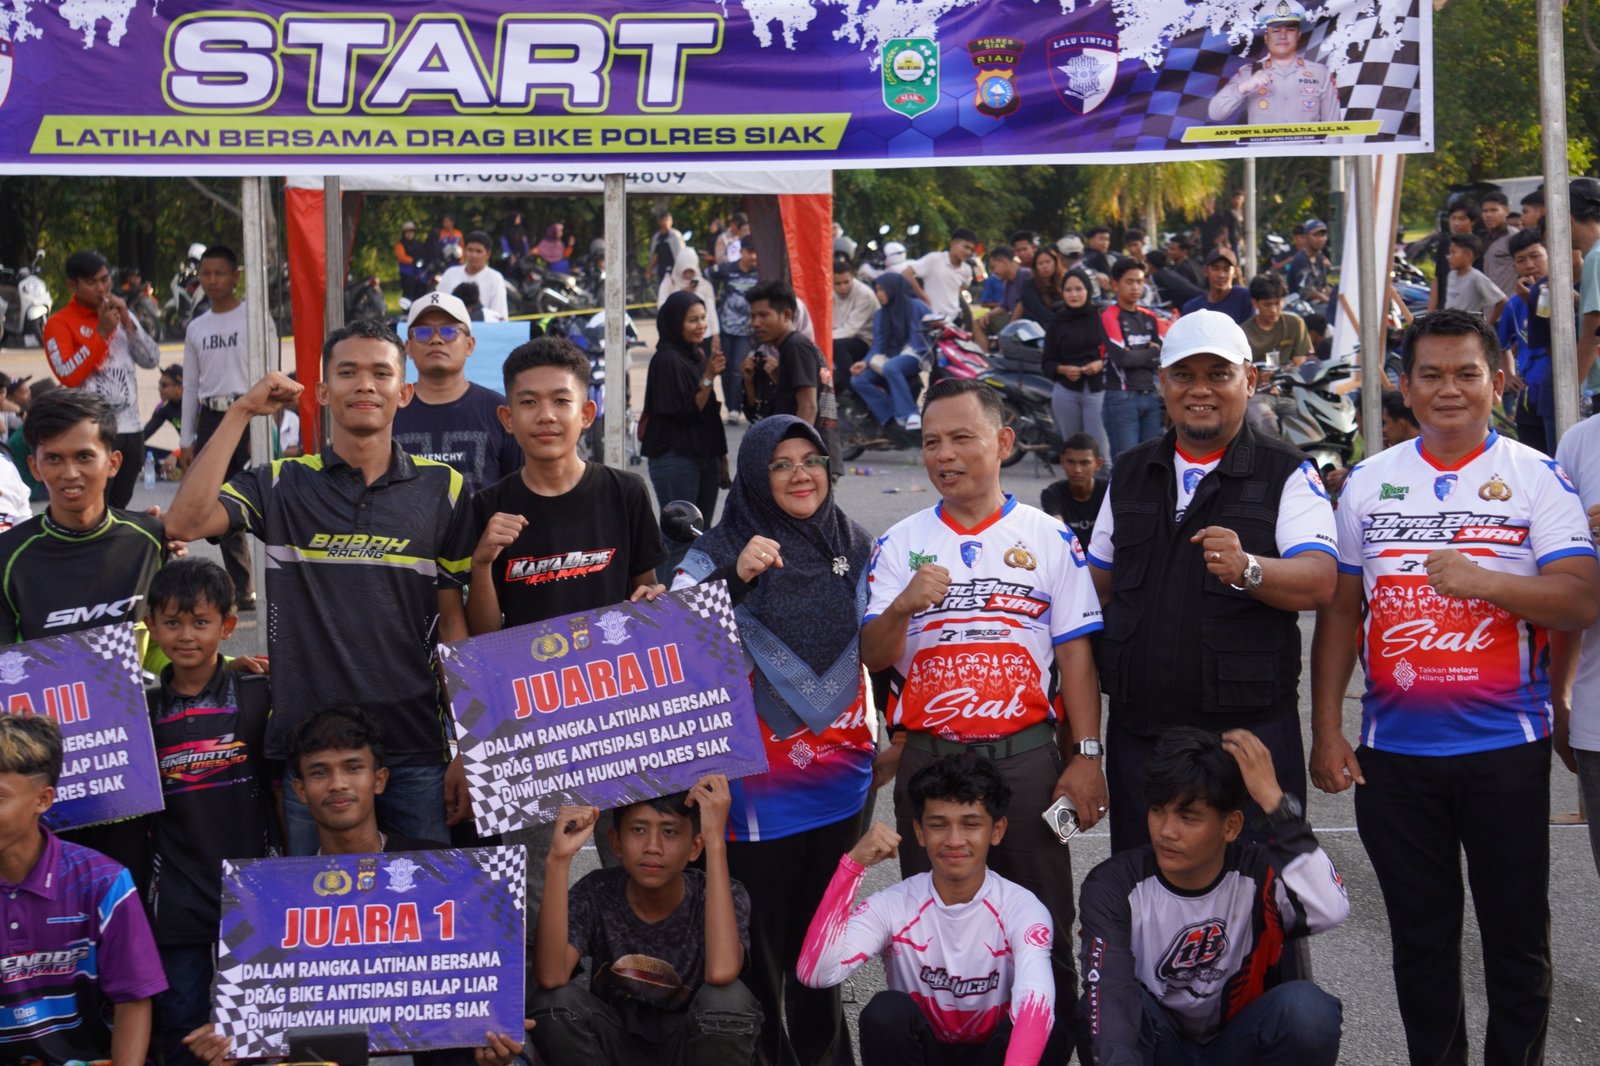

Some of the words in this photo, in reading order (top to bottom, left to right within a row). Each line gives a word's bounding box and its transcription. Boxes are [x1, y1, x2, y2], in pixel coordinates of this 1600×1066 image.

[977, 38, 1014, 46] POLRES
[1053, 37, 1079, 49] LALU
[1080, 36, 1113, 48] LINTAS
[164, 14, 722, 113] START
[976, 55, 1014, 64] RIAU
[55, 129, 210, 147] LATIHAN
[219, 129, 398, 147] BERSAMA
[406, 129, 505, 147] DRAG
[514, 129, 593, 147] BIKE
[601, 127, 737, 146] POLRES
[745, 126, 825, 144] SIAK
[308, 533, 410, 553] BABAH
[1363, 528, 1462, 544] POLRES
[1458, 527, 1526, 543] SIAK
[327, 549, 385, 559] RACING
[988, 594, 1044, 614] SIAK
[1382, 618, 1494, 658] Siak
[1419, 675, 1444, 683] Hilang
[1449, 666, 1478, 675] Melayu
[512, 653, 648, 720] JUARA
[648, 643, 685, 688] II
[923, 685, 1027, 728] Siak
[484, 735, 536, 758] DALAM
[540, 718, 598, 745] RANGKA
[599, 704, 660, 732] LATIHAN
[662, 687, 731, 716] BERSAMA
[492, 757, 533, 781] DRAG
[536, 749, 569, 771] BIKE
[571, 731, 648, 763] ANTISIPASI
[650, 723, 697, 750] BALAP
[700, 711, 733, 734] LIAR
[94, 750, 129, 767] LIAR
[588, 757, 638, 782] HUKUM
[641, 745, 694, 770] POLRES
[697, 736, 732, 758] SIAK
[89, 774, 125, 795] SIAK
[282, 902, 421, 948] JUARA
[433, 900, 455, 941] 1
[242, 962, 295, 981] DALAM
[299, 959, 360, 978] RANGKA
[365, 956, 425, 975] LATIHAN
[431, 951, 501, 971] BERSAMA
[244, 987, 286, 1005] DRAG
[289, 985, 325, 1003] BIKE
[328, 981, 408, 1001] ANTISIPASI
[411, 978, 460, 997] BALAP
[463, 976, 498, 993] LIAR
[339, 1006, 391, 1026] HUKUM
[395, 1003, 451, 1022] POLRES
[455, 1000, 490, 1018] SIAK
